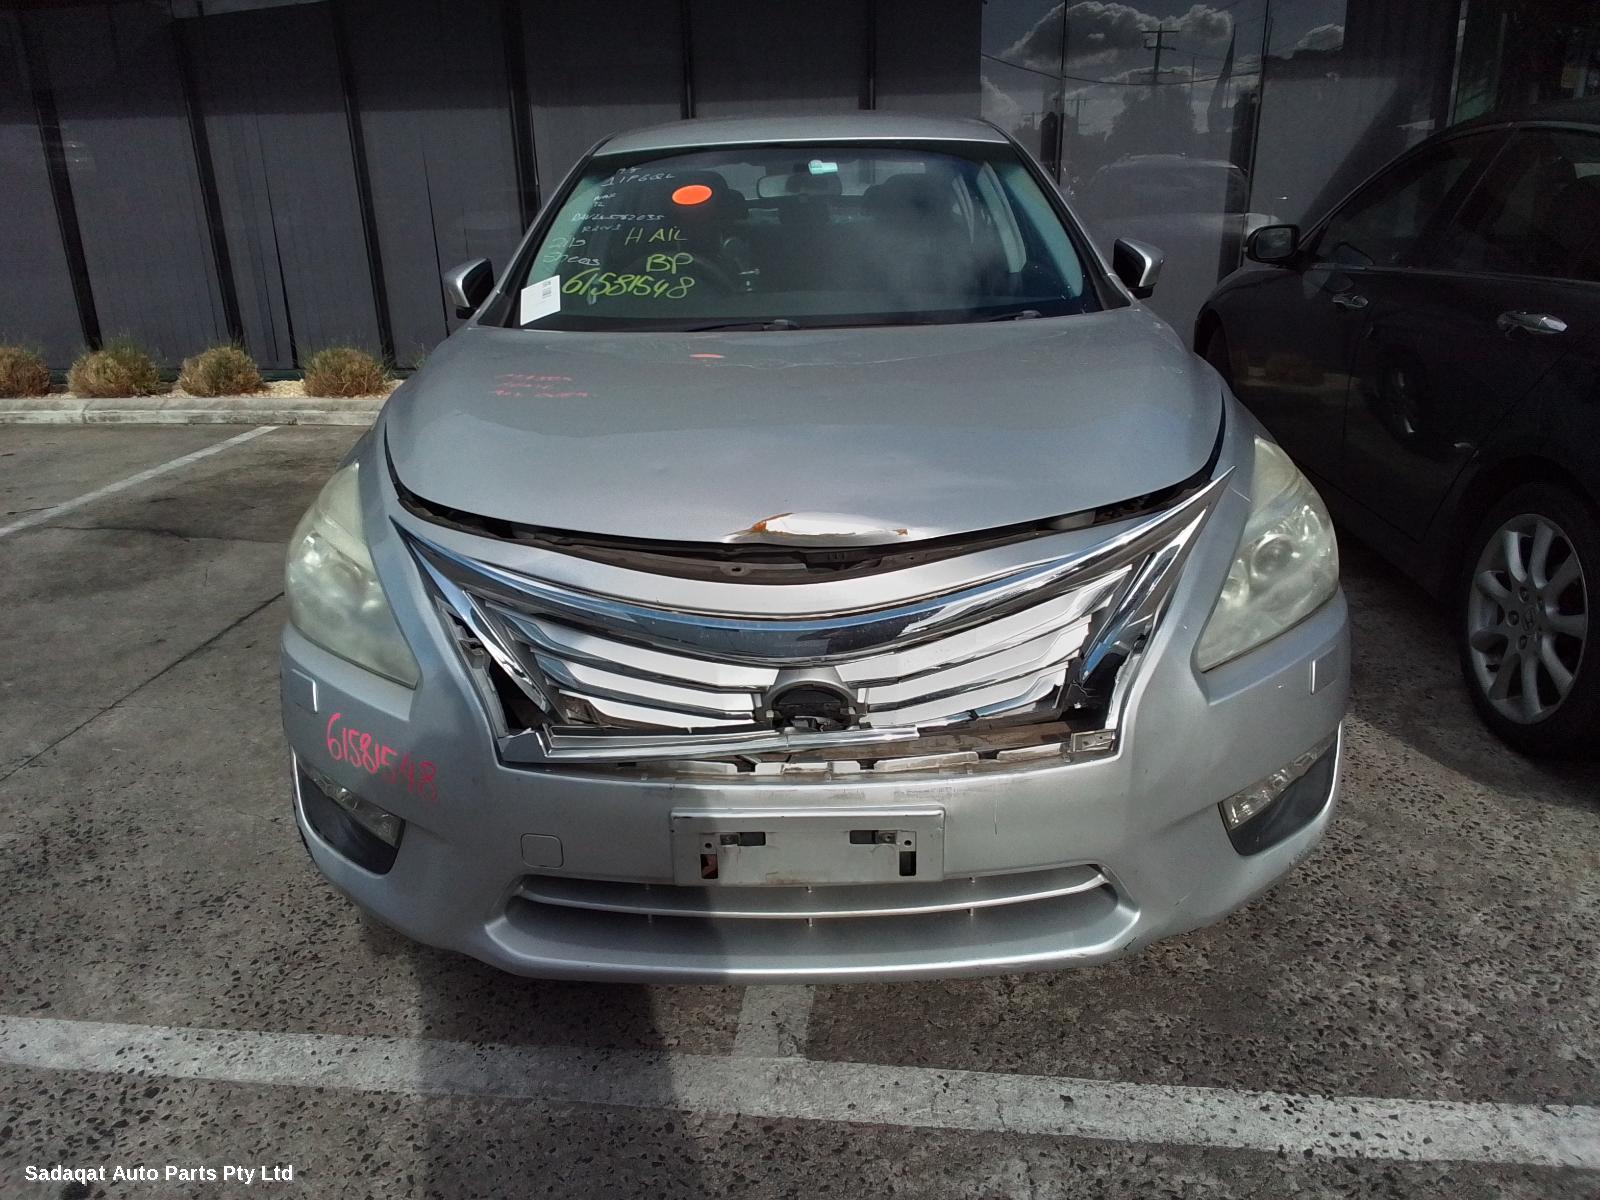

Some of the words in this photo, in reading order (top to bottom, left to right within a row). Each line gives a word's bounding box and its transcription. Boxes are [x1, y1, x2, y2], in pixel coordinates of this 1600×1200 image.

[646, 252, 693, 274] BP
[561, 267, 695, 299] 61581548
[326, 712, 438, 802] 61581548
